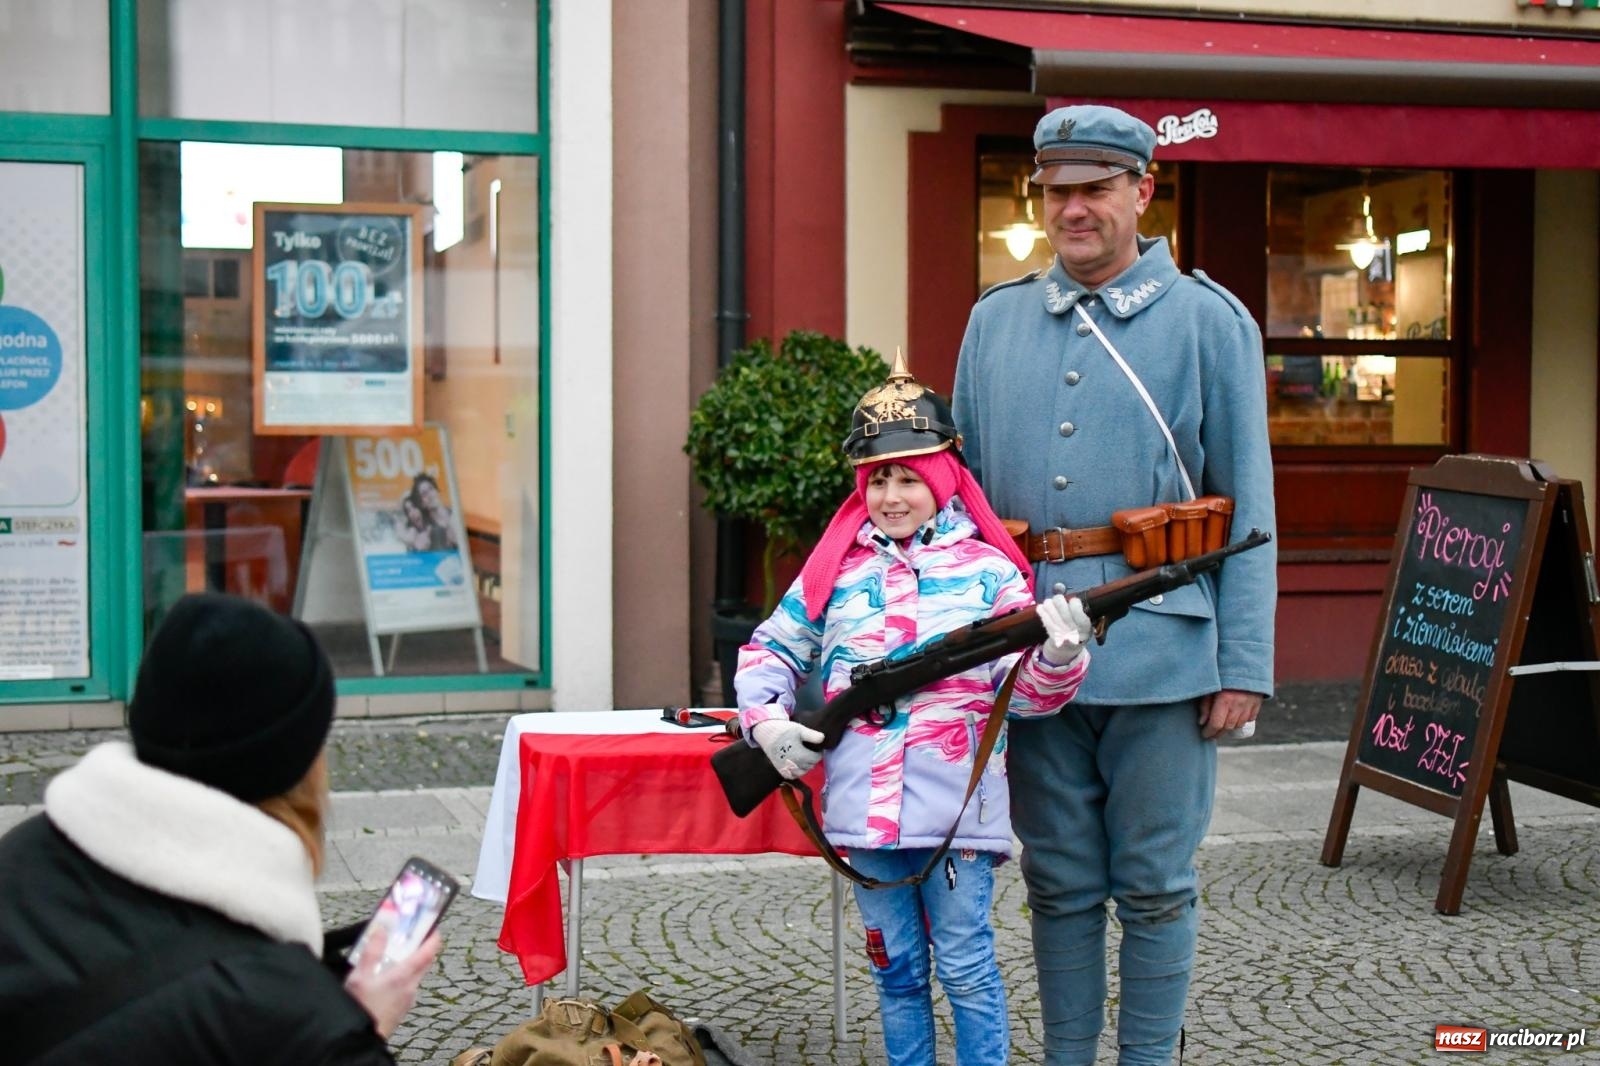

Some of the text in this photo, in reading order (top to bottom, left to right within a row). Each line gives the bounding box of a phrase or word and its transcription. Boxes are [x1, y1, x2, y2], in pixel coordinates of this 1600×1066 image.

[273, 231, 322, 252] Tylko
[358, 225, 388, 248] BEZ
[266, 259, 371, 318] 100
[0, 331, 47, 349] odna
[354, 437, 424, 479] 500
[1417, 504, 1511, 600] Pierogi
[1412, 582, 1475, 616] z serem
[1393, 606, 1498, 667] i ziemniakami
[1426, 661, 1439, 685] z
[1372, 712, 1415, 751] 10szt
